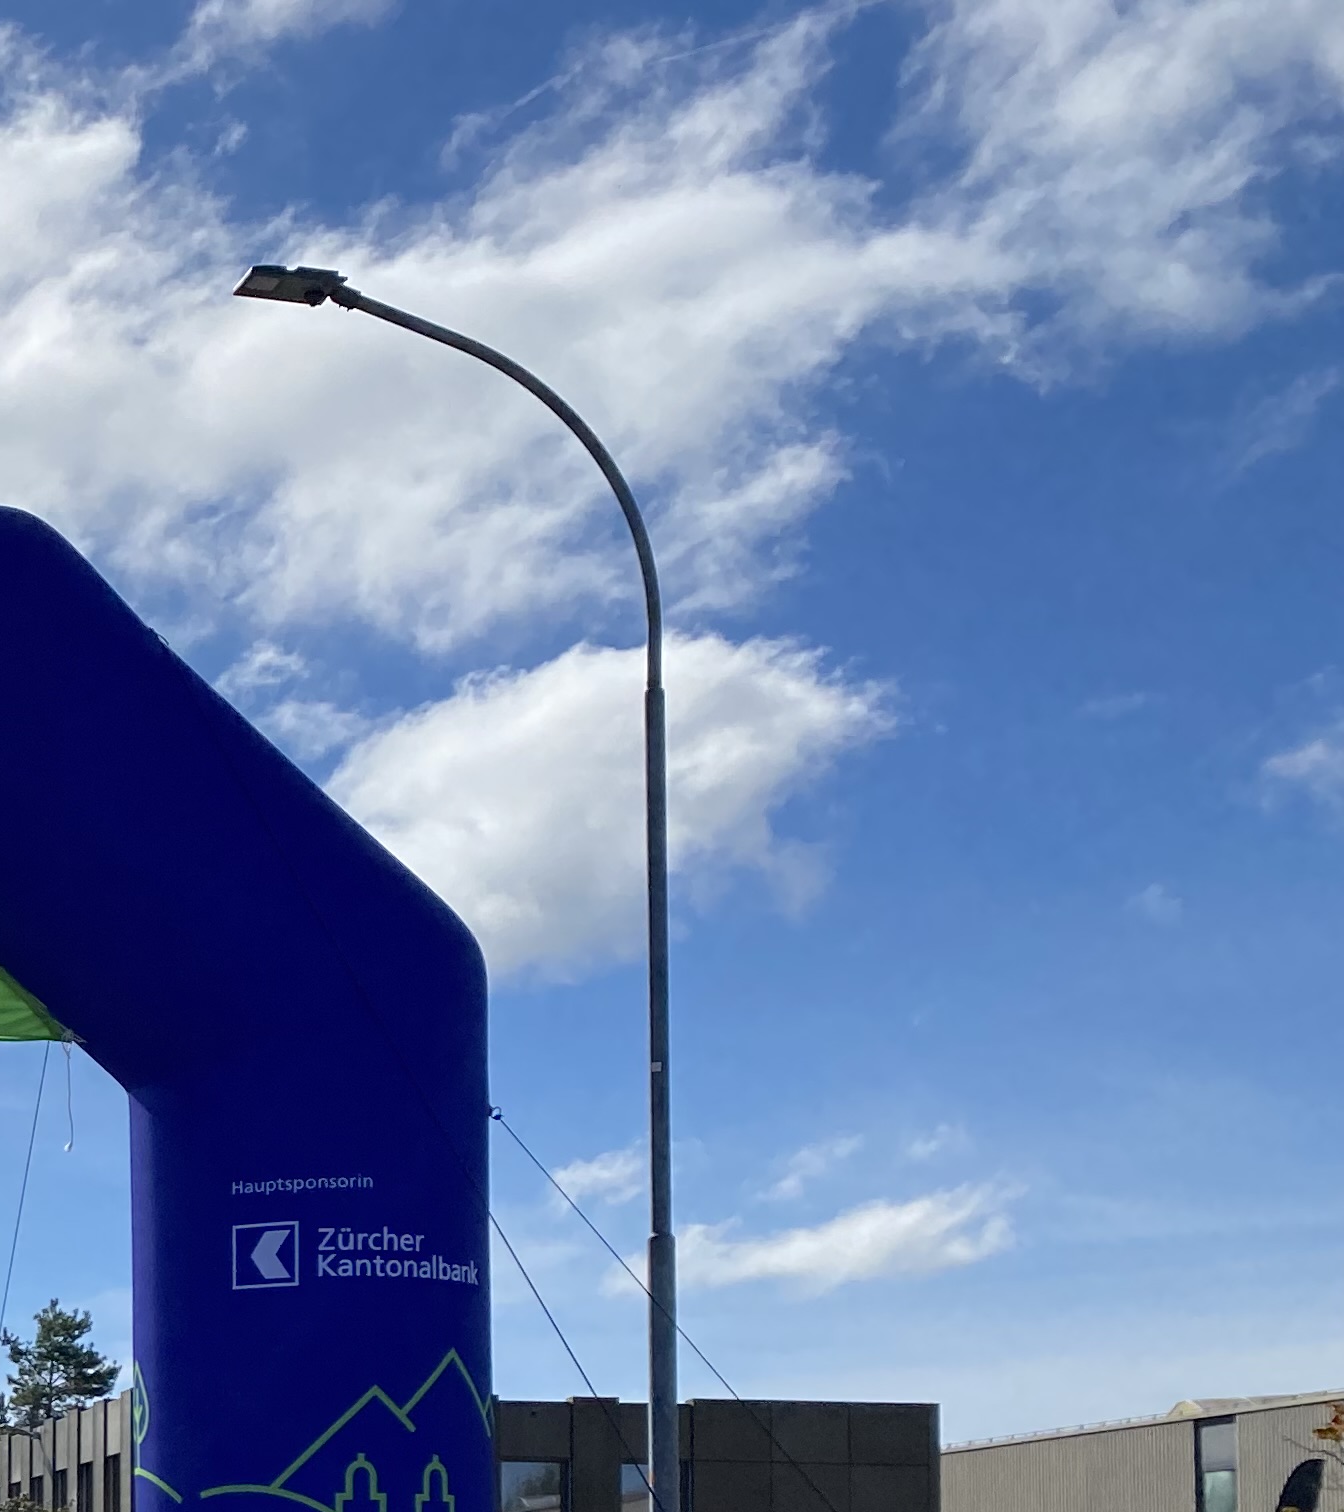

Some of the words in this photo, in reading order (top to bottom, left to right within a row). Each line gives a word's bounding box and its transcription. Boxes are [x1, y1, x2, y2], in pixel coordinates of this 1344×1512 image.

[231, 1174, 374, 1195] Hauptsponsorin
[317, 1226, 425, 1253] Zürcher
[317, 1254, 479, 1286] Kantonalbank
